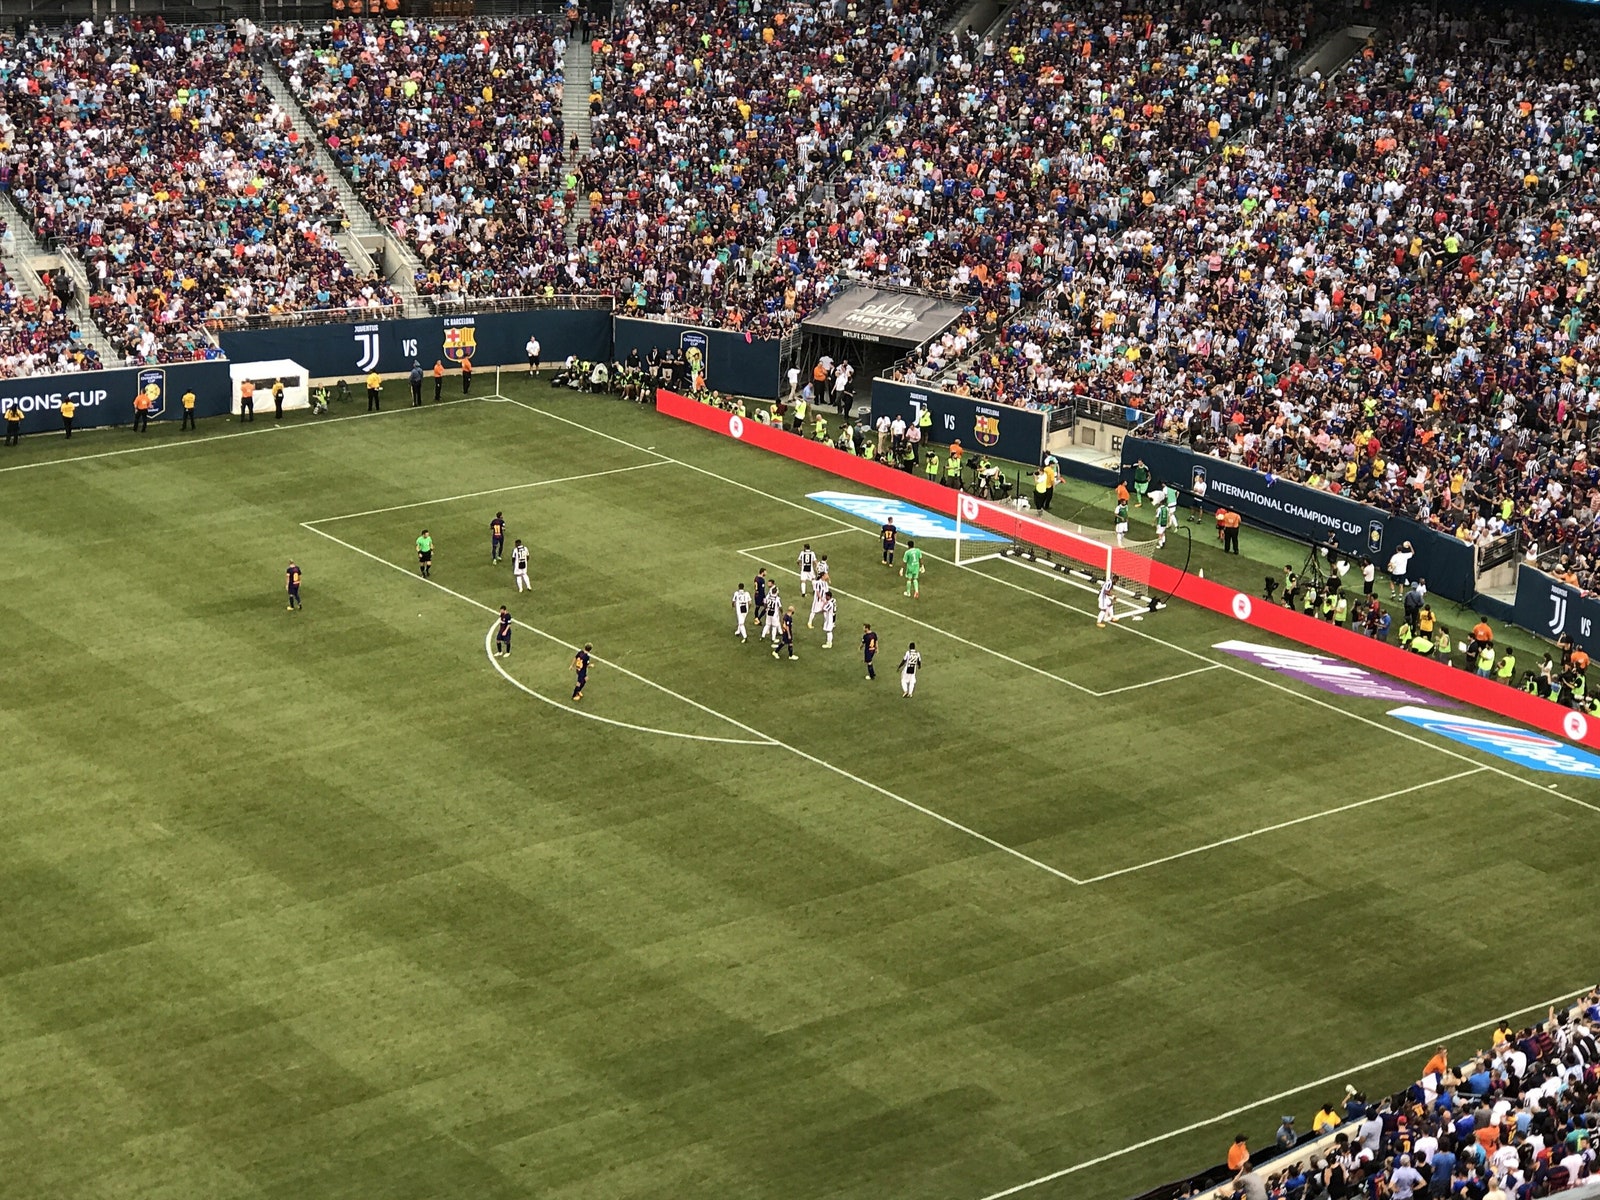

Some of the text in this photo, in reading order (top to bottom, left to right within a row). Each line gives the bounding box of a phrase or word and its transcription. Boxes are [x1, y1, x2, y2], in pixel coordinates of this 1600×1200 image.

[450, 317, 475, 326] BARCELONA
[845, 314, 907, 329] MetLife
[354, 324, 379, 333] JUVENTUS
[403, 339, 418, 357] VS
[67, 389, 107, 407] CUP
[943, 413, 956, 431] VS
[1211, 479, 1362, 536] INTERNATIONAL CHAMPIONS CUP
[884, 530, 893, 538] 17
[804, 554, 810, 564] 8
[912, 552, 917, 562] 1
[1580, 616, 1592, 637] VS
[908, 655, 918, 664] 22
